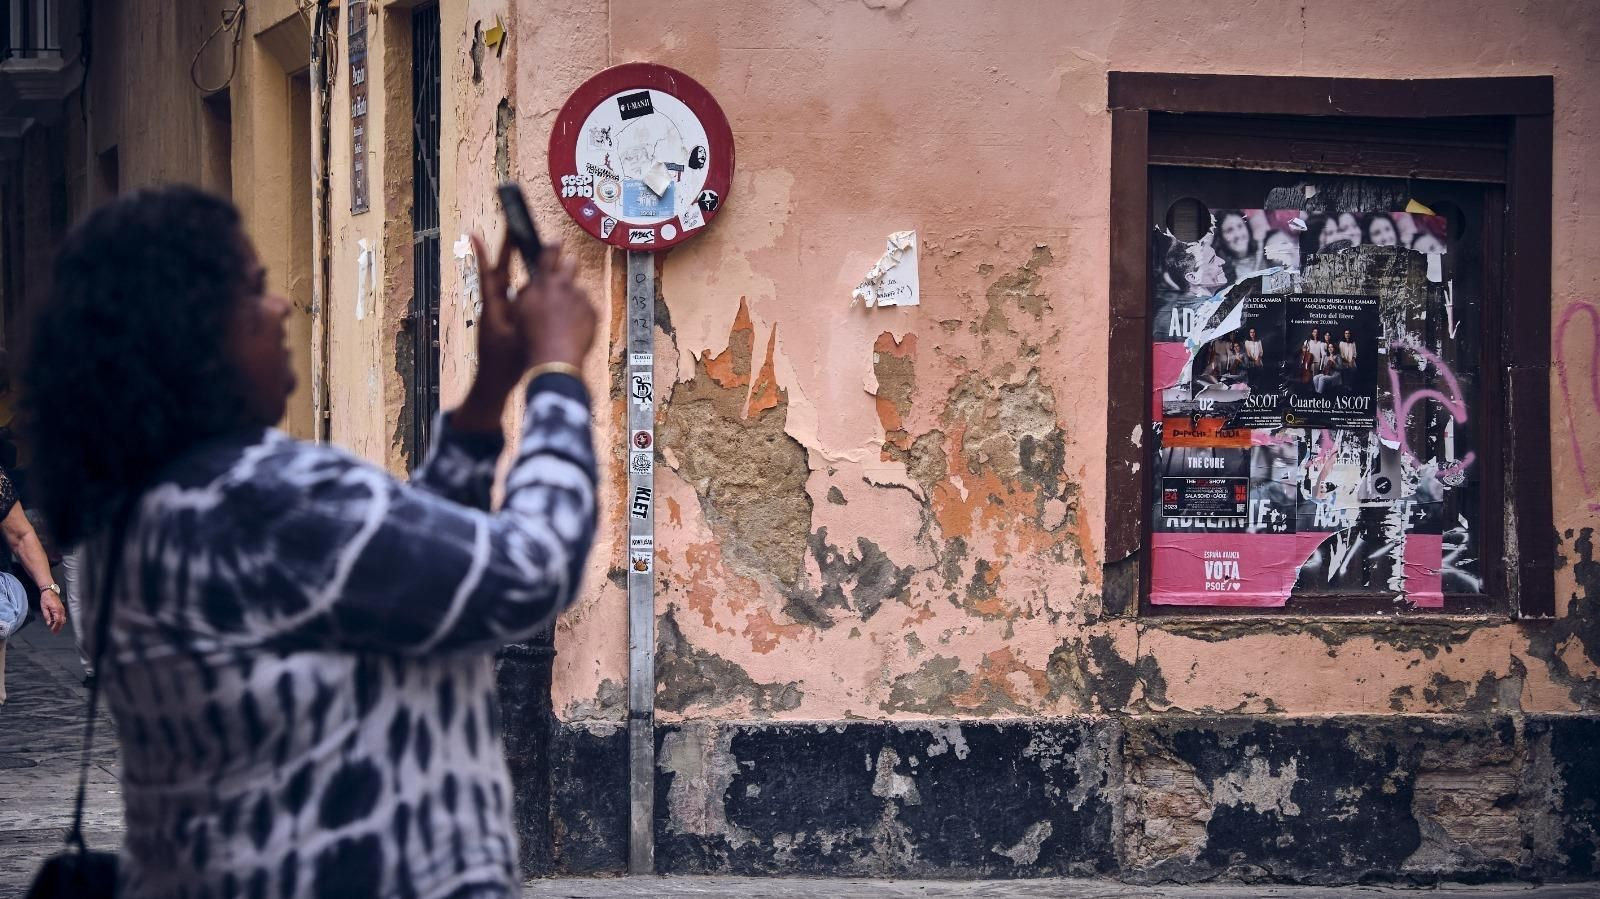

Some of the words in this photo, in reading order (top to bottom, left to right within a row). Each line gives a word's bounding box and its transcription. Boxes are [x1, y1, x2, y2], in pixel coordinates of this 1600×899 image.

[1199, 397, 1214, 411] U2
[1289, 393, 1331, 409] Cuarteto
[1332, 395, 1371, 410] ASCOT
[1187, 456, 1202, 469] THE
[1203, 457, 1225, 469] CURE
[1204, 560, 1240, 580] VOTA
[1205, 581, 1226, 591] PSOE
